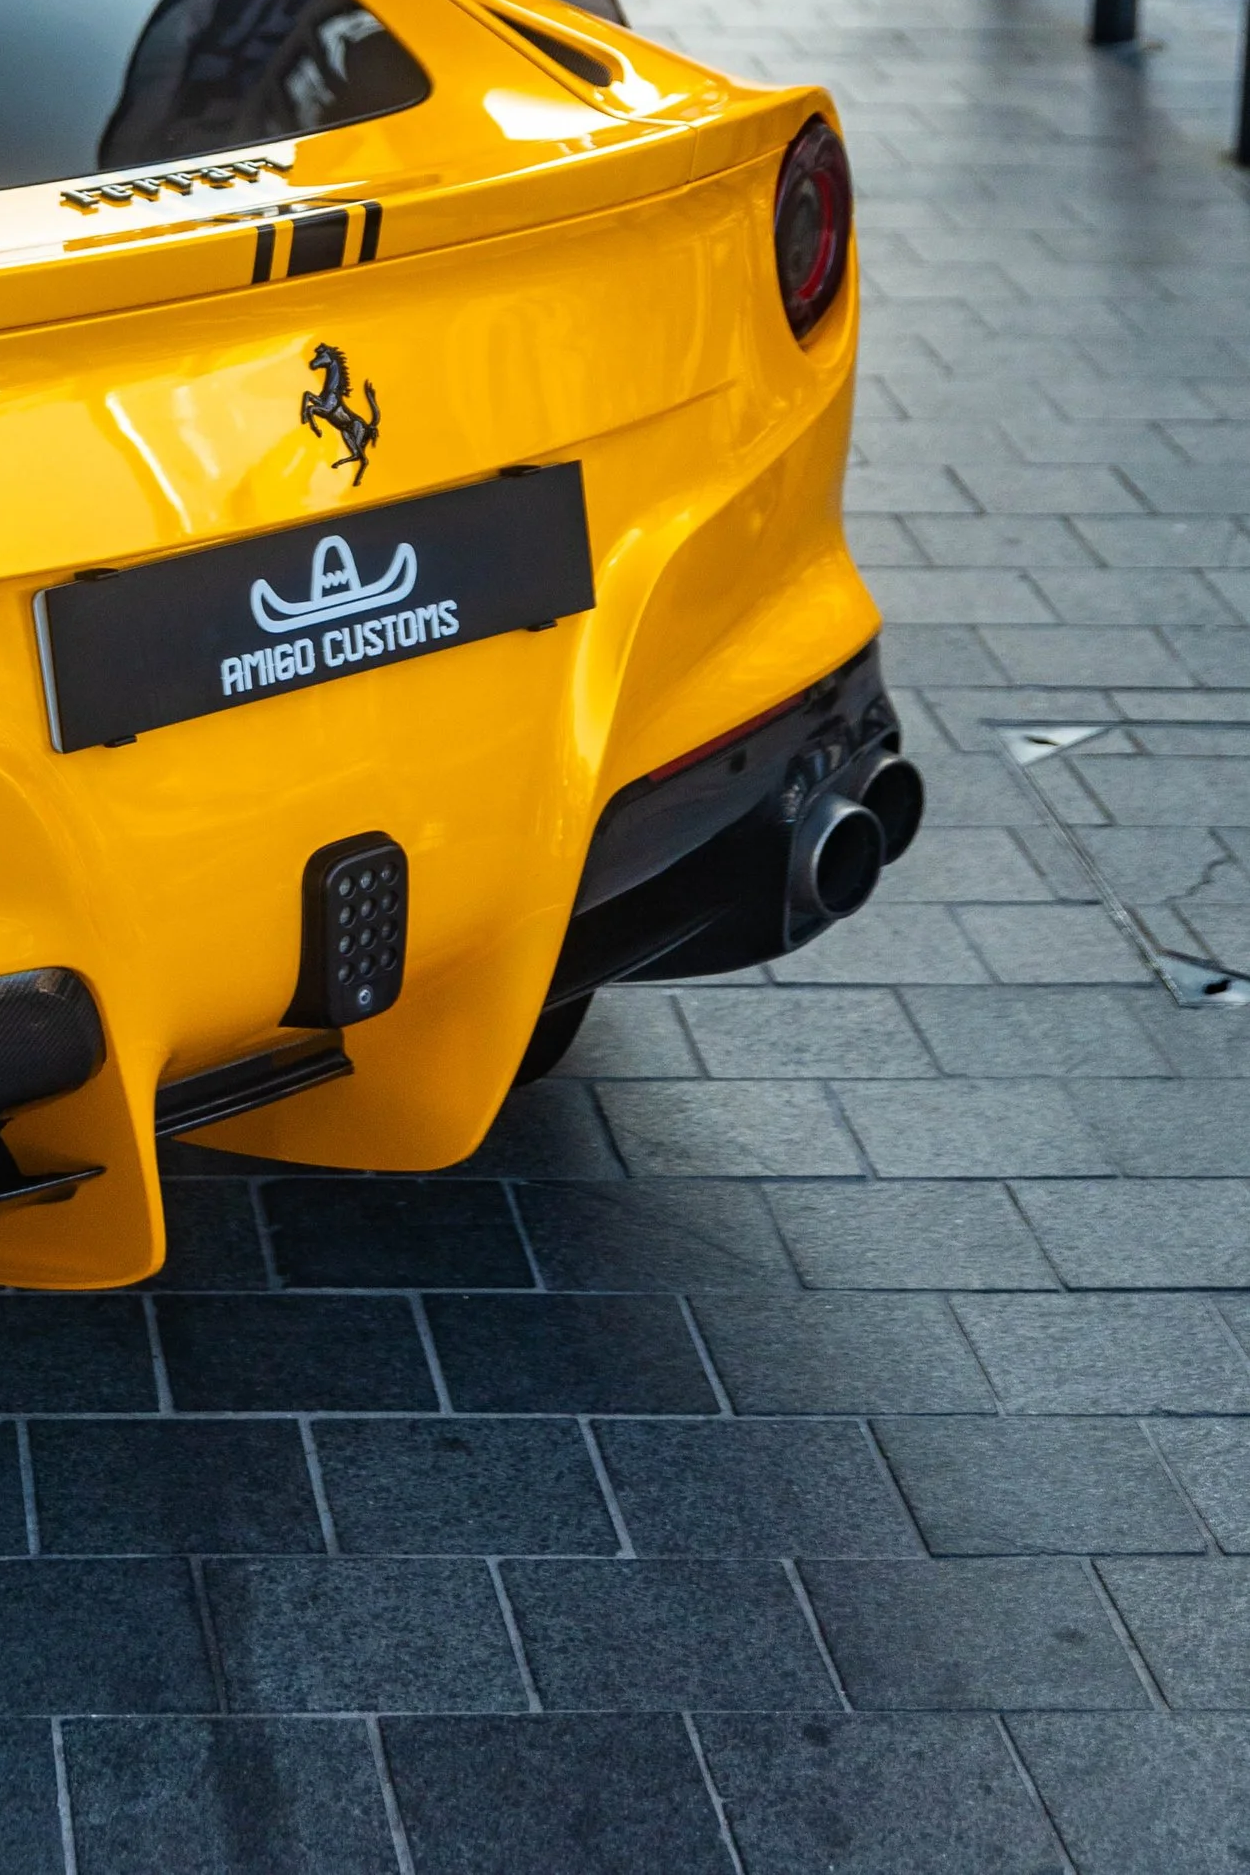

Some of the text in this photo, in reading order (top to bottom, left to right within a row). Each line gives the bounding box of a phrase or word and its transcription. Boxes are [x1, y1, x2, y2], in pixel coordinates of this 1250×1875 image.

[60, 157, 293, 209] Ferrari
[220, 600, 460, 696] AMIGO CUSTOMS
